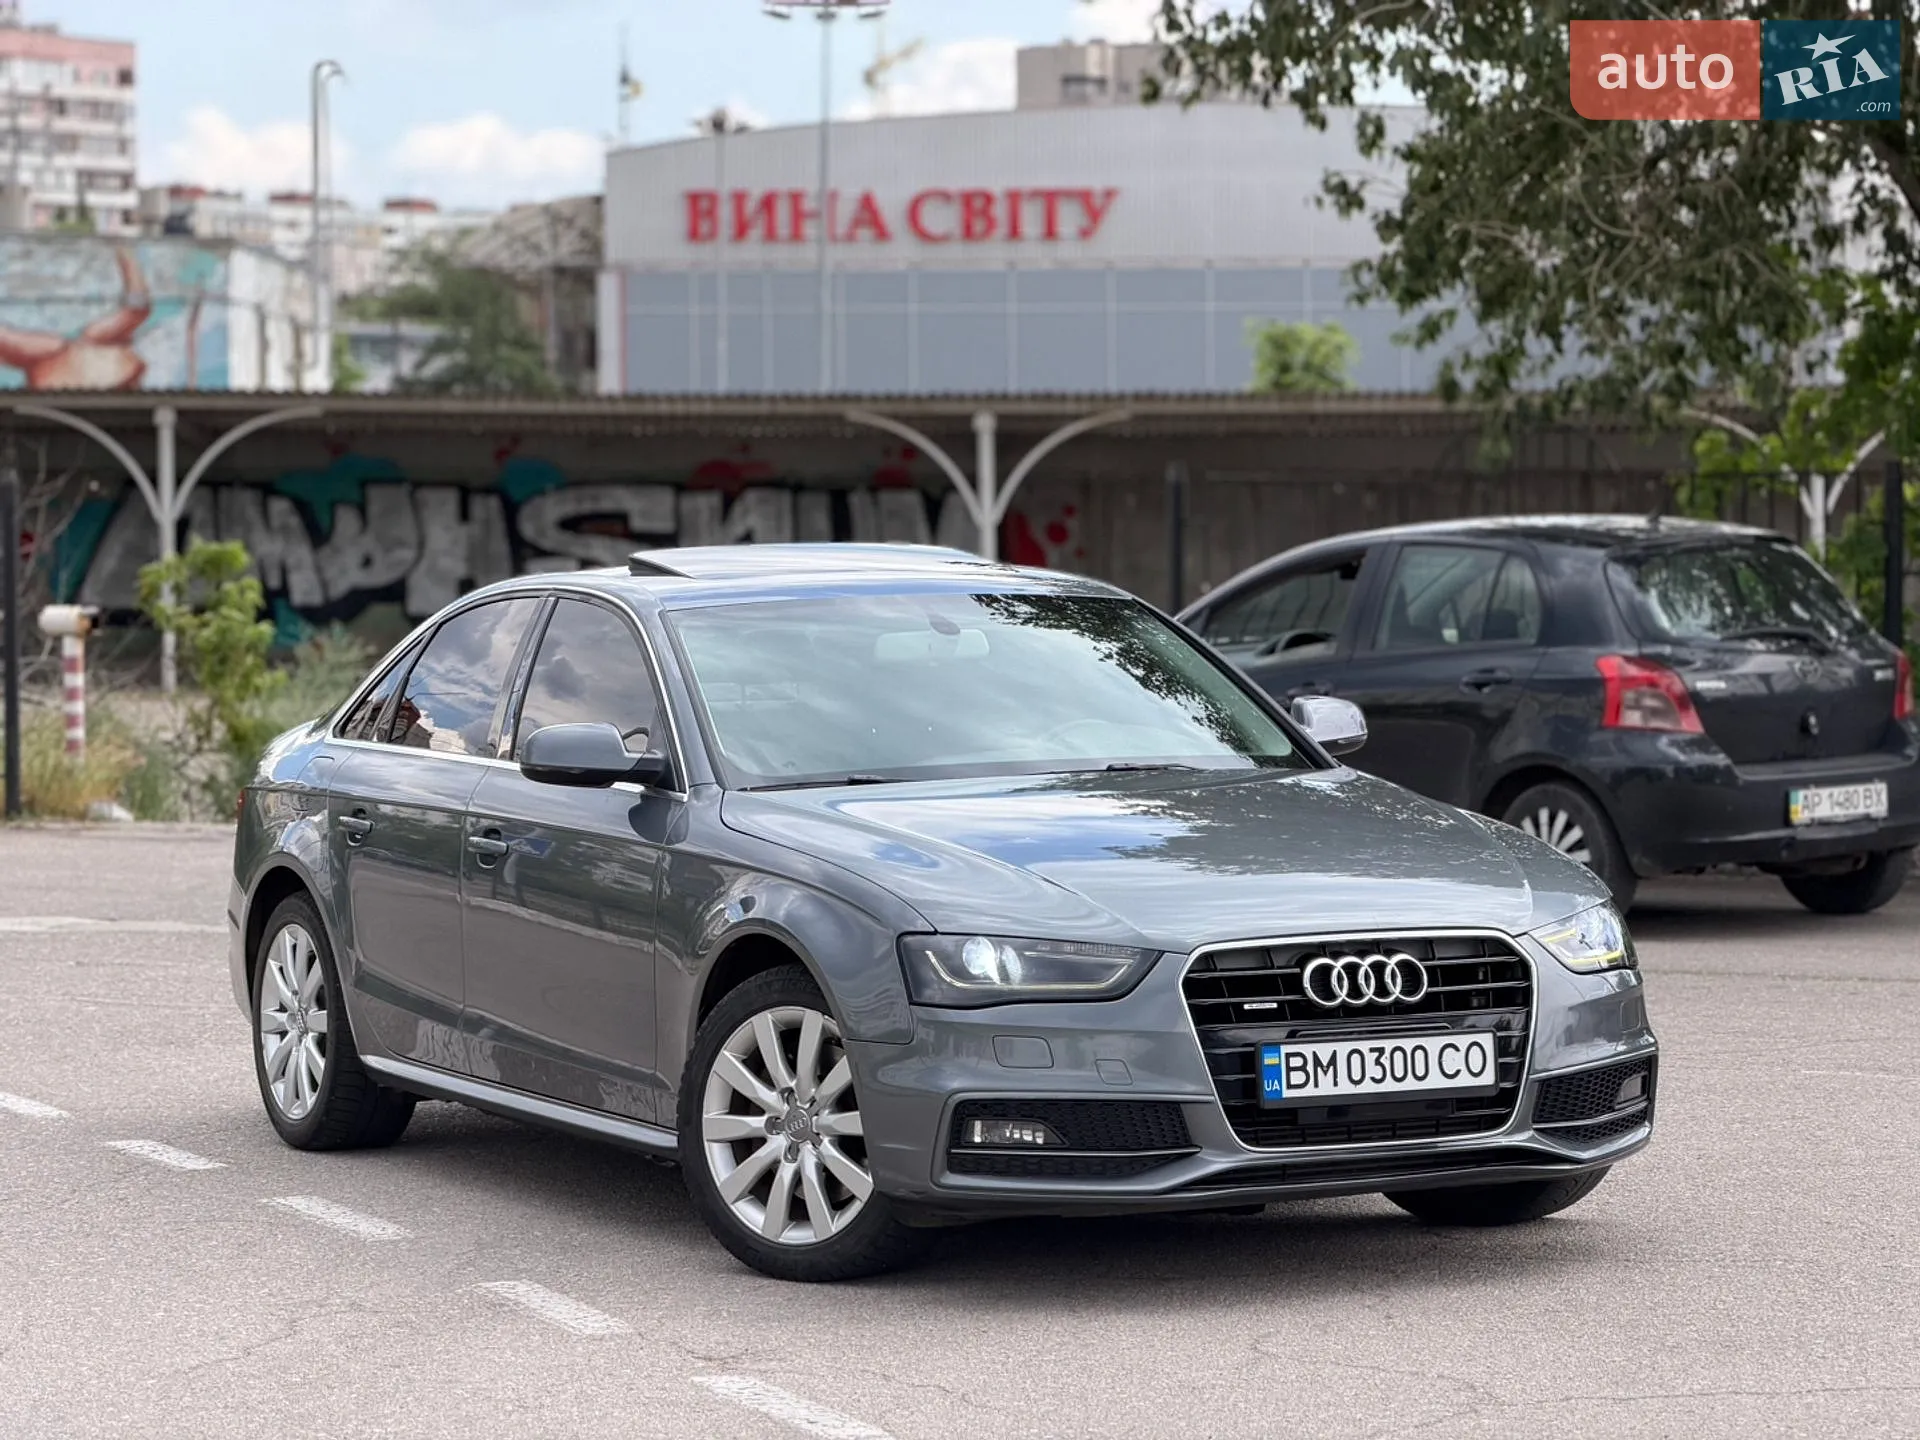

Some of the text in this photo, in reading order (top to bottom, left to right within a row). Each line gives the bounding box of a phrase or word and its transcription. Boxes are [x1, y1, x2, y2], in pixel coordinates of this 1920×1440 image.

[684, 187, 1118, 244] ВИНА СВІТУ
[1827, 788, 1860, 812] 1480
[1863, 785, 1885, 809] BX
[1285, 1041, 1488, 1090] BM 0300 CO
[1264, 1080, 1281, 1092] UA
